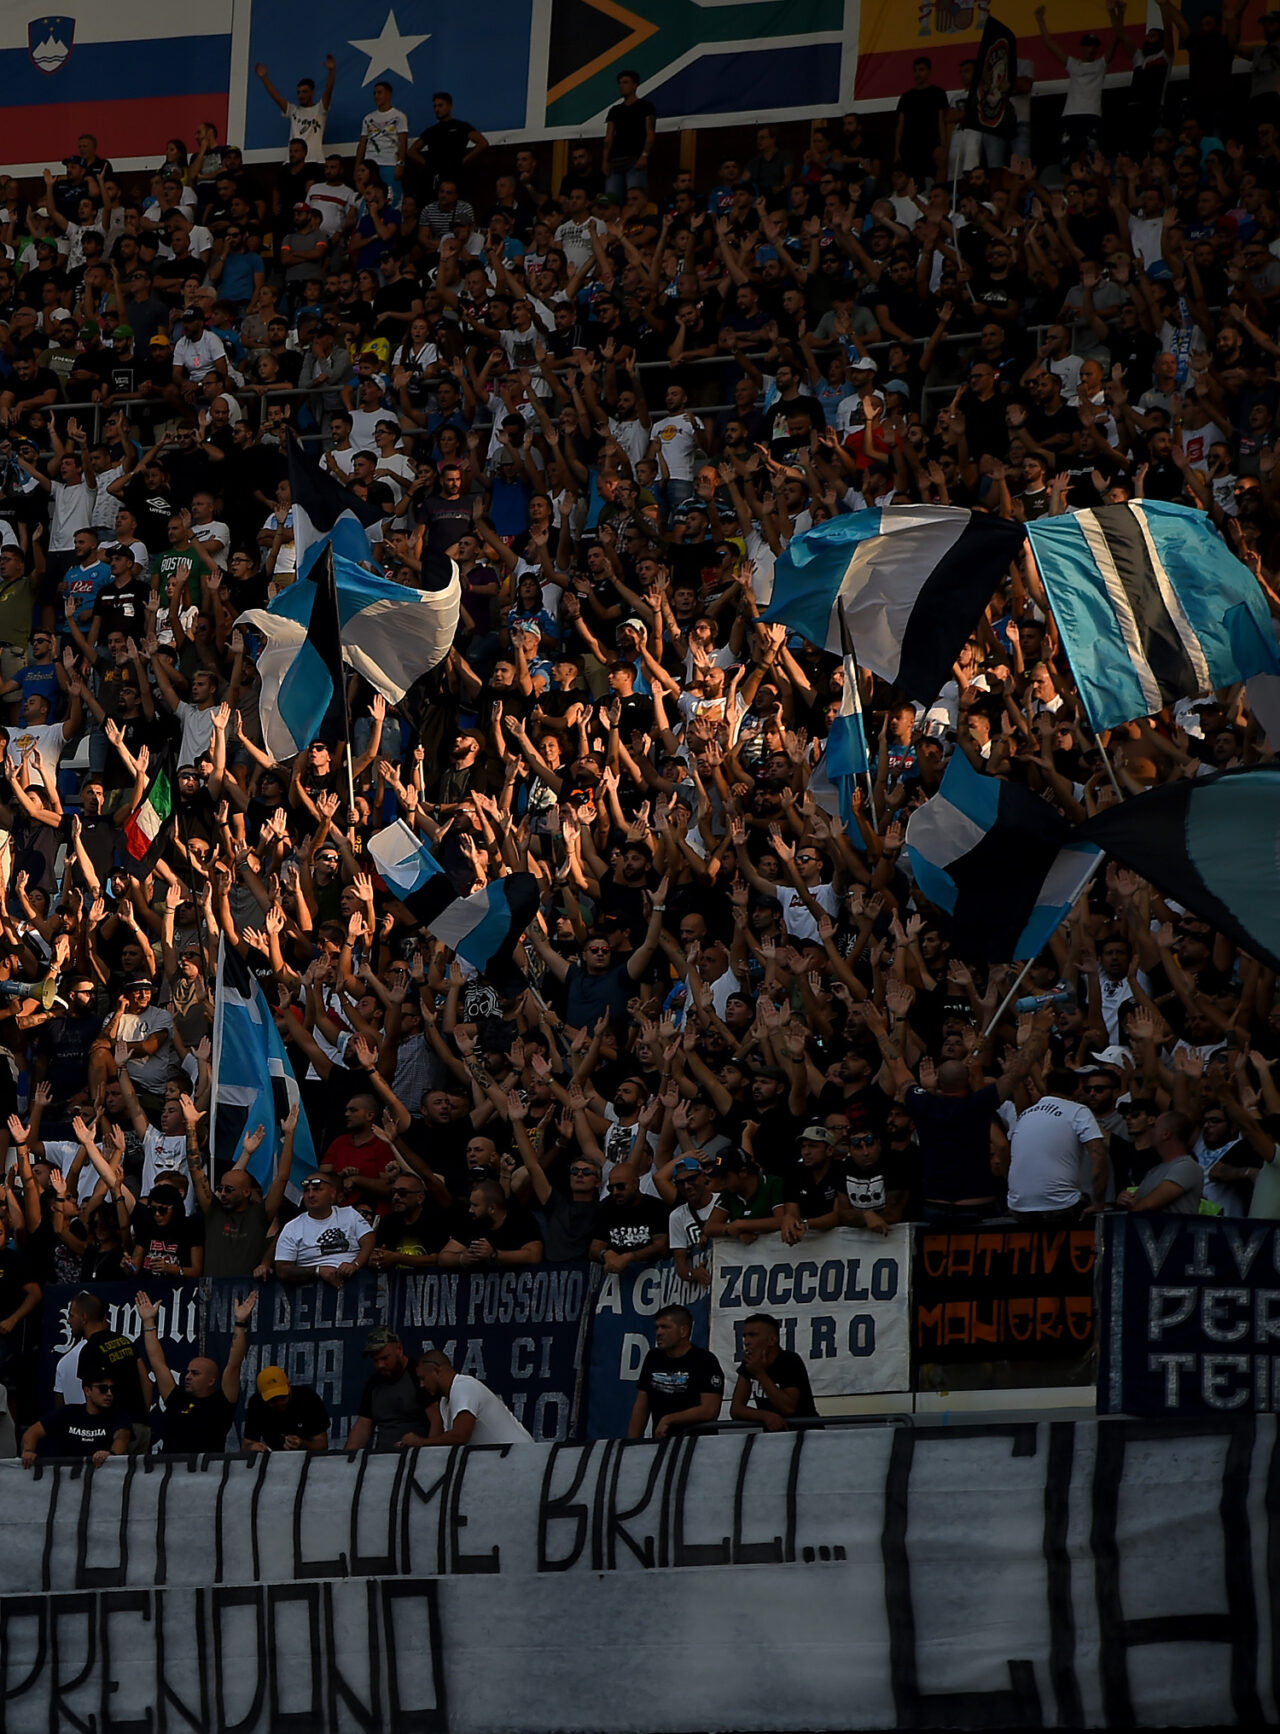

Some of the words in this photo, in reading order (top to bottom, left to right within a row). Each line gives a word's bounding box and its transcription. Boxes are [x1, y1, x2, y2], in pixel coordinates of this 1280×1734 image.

[922, 1228, 1096, 1279] CATTIVE
[1133, 1218, 1280, 1281] VIV
[403, 1274, 460, 1328] NON
[467, 1269, 583, 1326] POSSONO
[719, 1258, 899, 1308] ZOCCOLO
[917, 1296, 1094, 1349] MANIERE
[510, 1335, 554, 1380] CI
[32, 1449, 272, 1592] TUTTI
[293, 1443, 512, 1576] COME
[0, 1580, 450, 1734] PRENDONO
